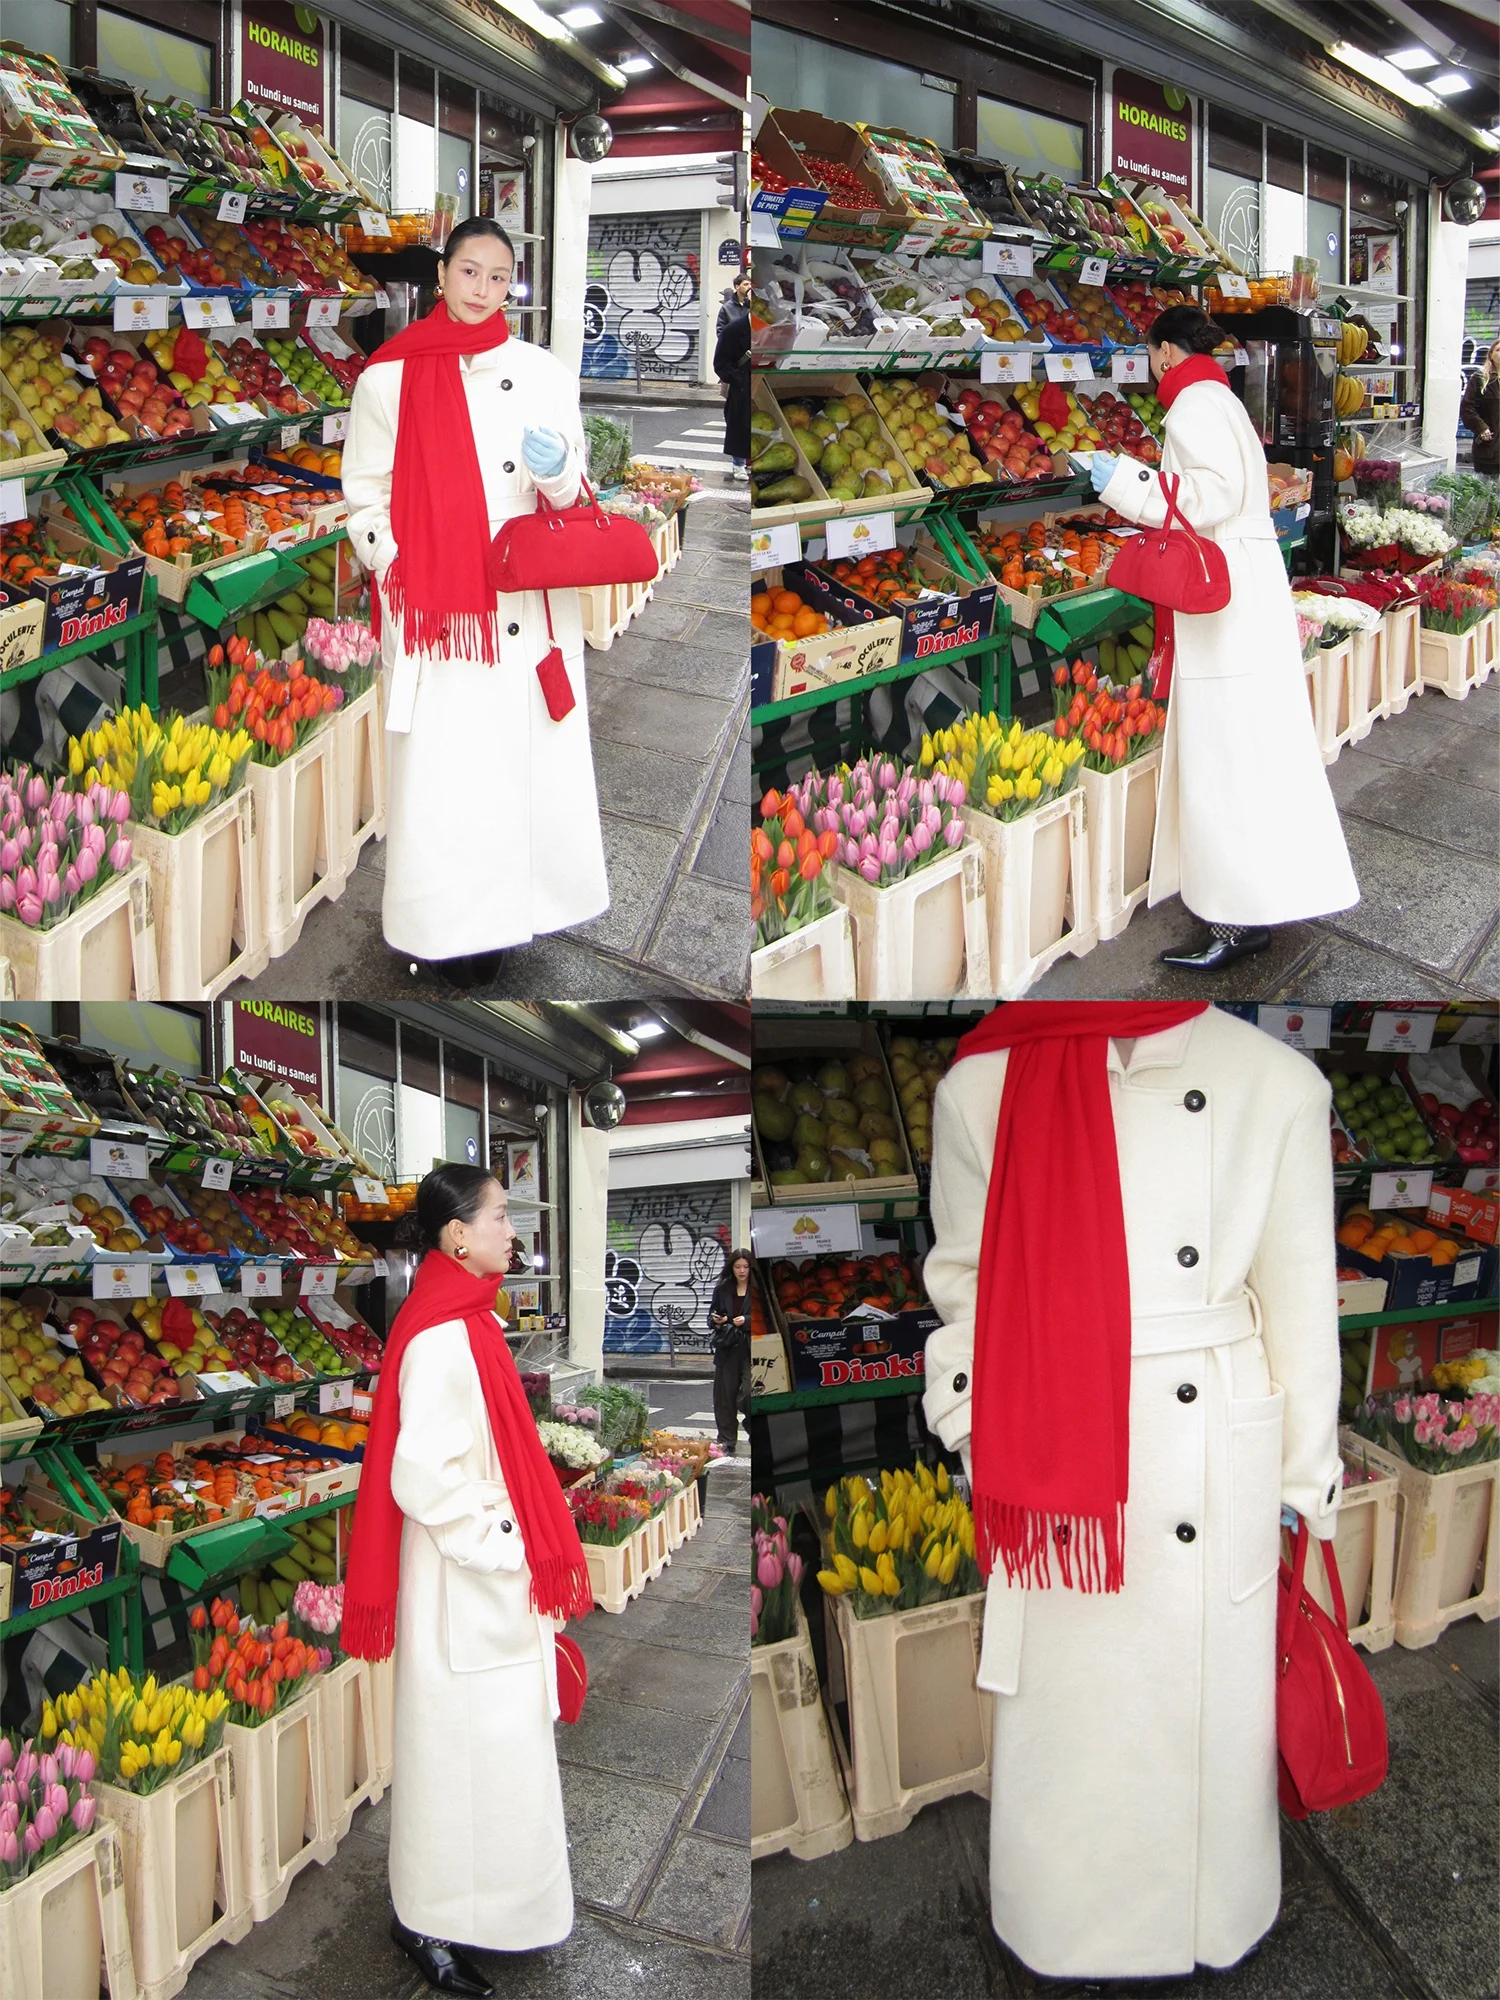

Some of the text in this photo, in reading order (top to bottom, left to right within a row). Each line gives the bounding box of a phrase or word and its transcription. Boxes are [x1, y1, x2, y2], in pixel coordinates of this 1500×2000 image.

[248, 21, 318, 67] HORAIRES
[247, 80, 320, 115] Du lundi au samedi
[1119, 102, 1186, 142] HORAIRES
[1117, 155, 1188, 185] Du lundi au samedi
[757, 201, 779, 211] DE PAYS
[761, 194, 785, 204] TOMATES
[58, 597, 128, 647] Dinki
[914, 620, 980, 659] Dinki
[240, 1001, 314, 1036] HORAIRES
[240, 1049, 317, 1084] Du lundi au samedi
[810, 1327, 847, 1339] Campal
[819, 1351, 926, 1386] Dinki
[29, 1562, 103, 1610] Dinki
